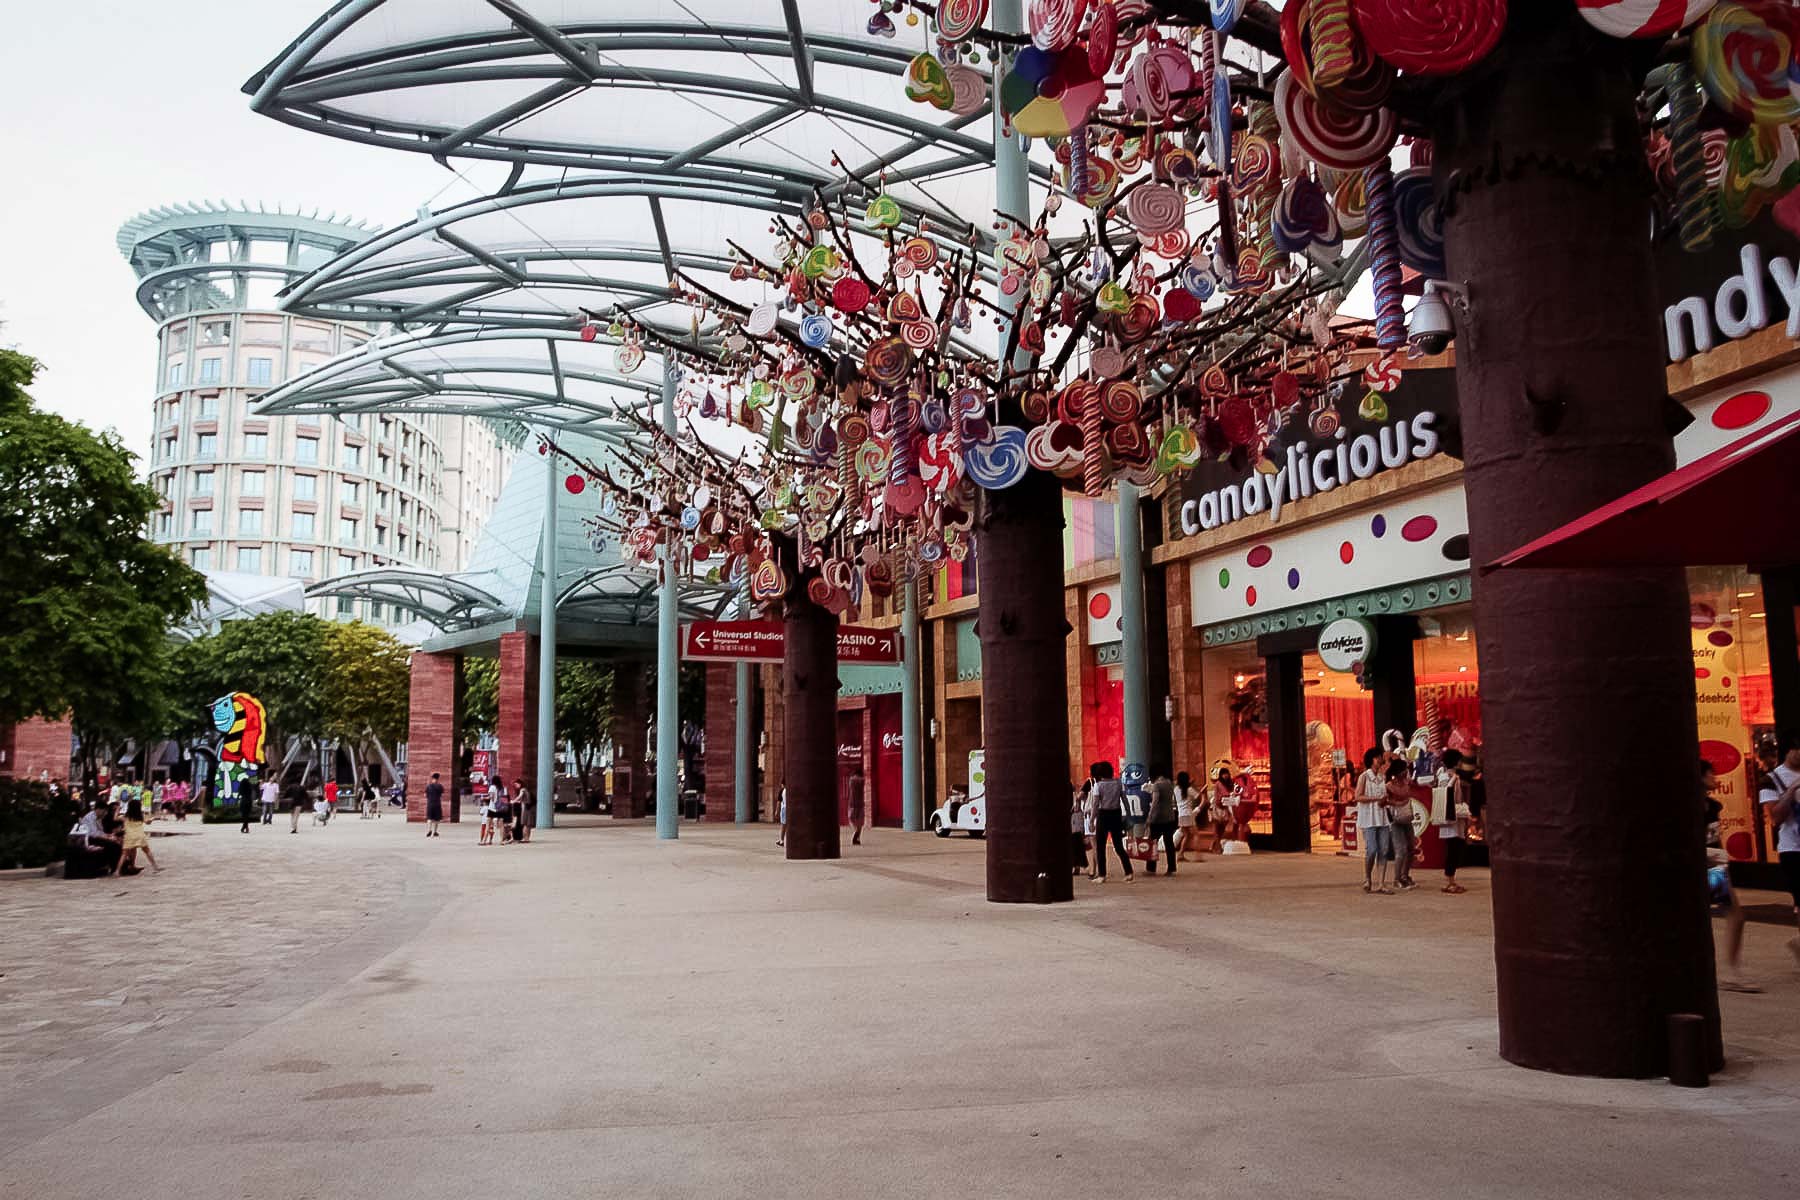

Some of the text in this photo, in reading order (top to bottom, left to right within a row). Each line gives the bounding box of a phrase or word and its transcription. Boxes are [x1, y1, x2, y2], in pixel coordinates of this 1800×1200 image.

[1665, 243, 1800, 362] ndy
[1181, 411, 1438, 536] candylicious
[713, 630, 784, 640] Universal Studios
